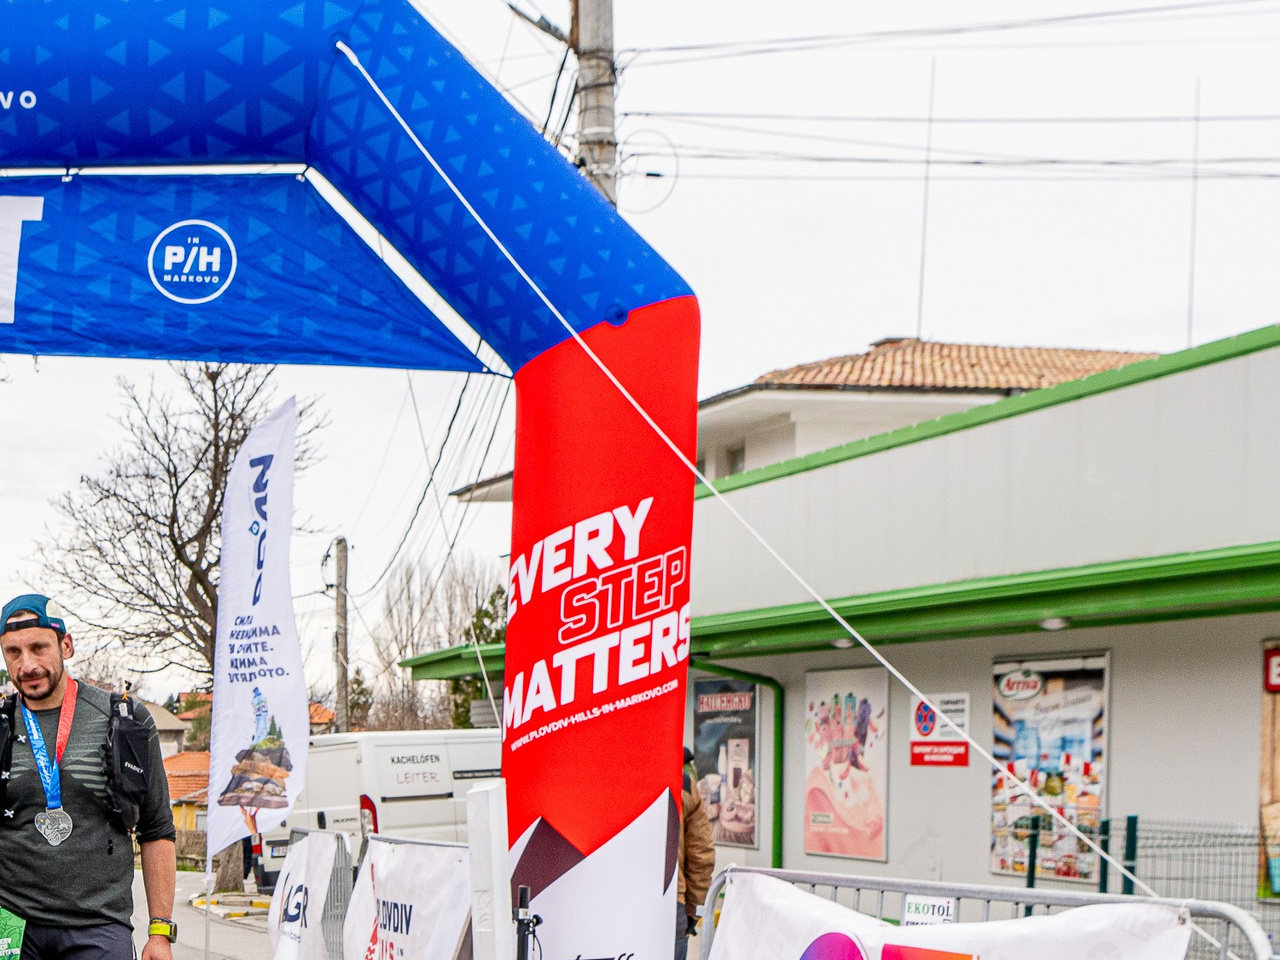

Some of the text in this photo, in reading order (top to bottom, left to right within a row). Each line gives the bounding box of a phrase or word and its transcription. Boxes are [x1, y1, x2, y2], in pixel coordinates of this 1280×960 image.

[187, 236, 200, 244] IN
[163, 245, 222, 274] P/H
[163, 274, 220, 284] MARKOVO
[507, 496, 654, 626] EVERY
[558, 545, 687, 645] STEP
[502, 602, 690, 743] MATTERS
[396, 771, 440, 784] LEITER
